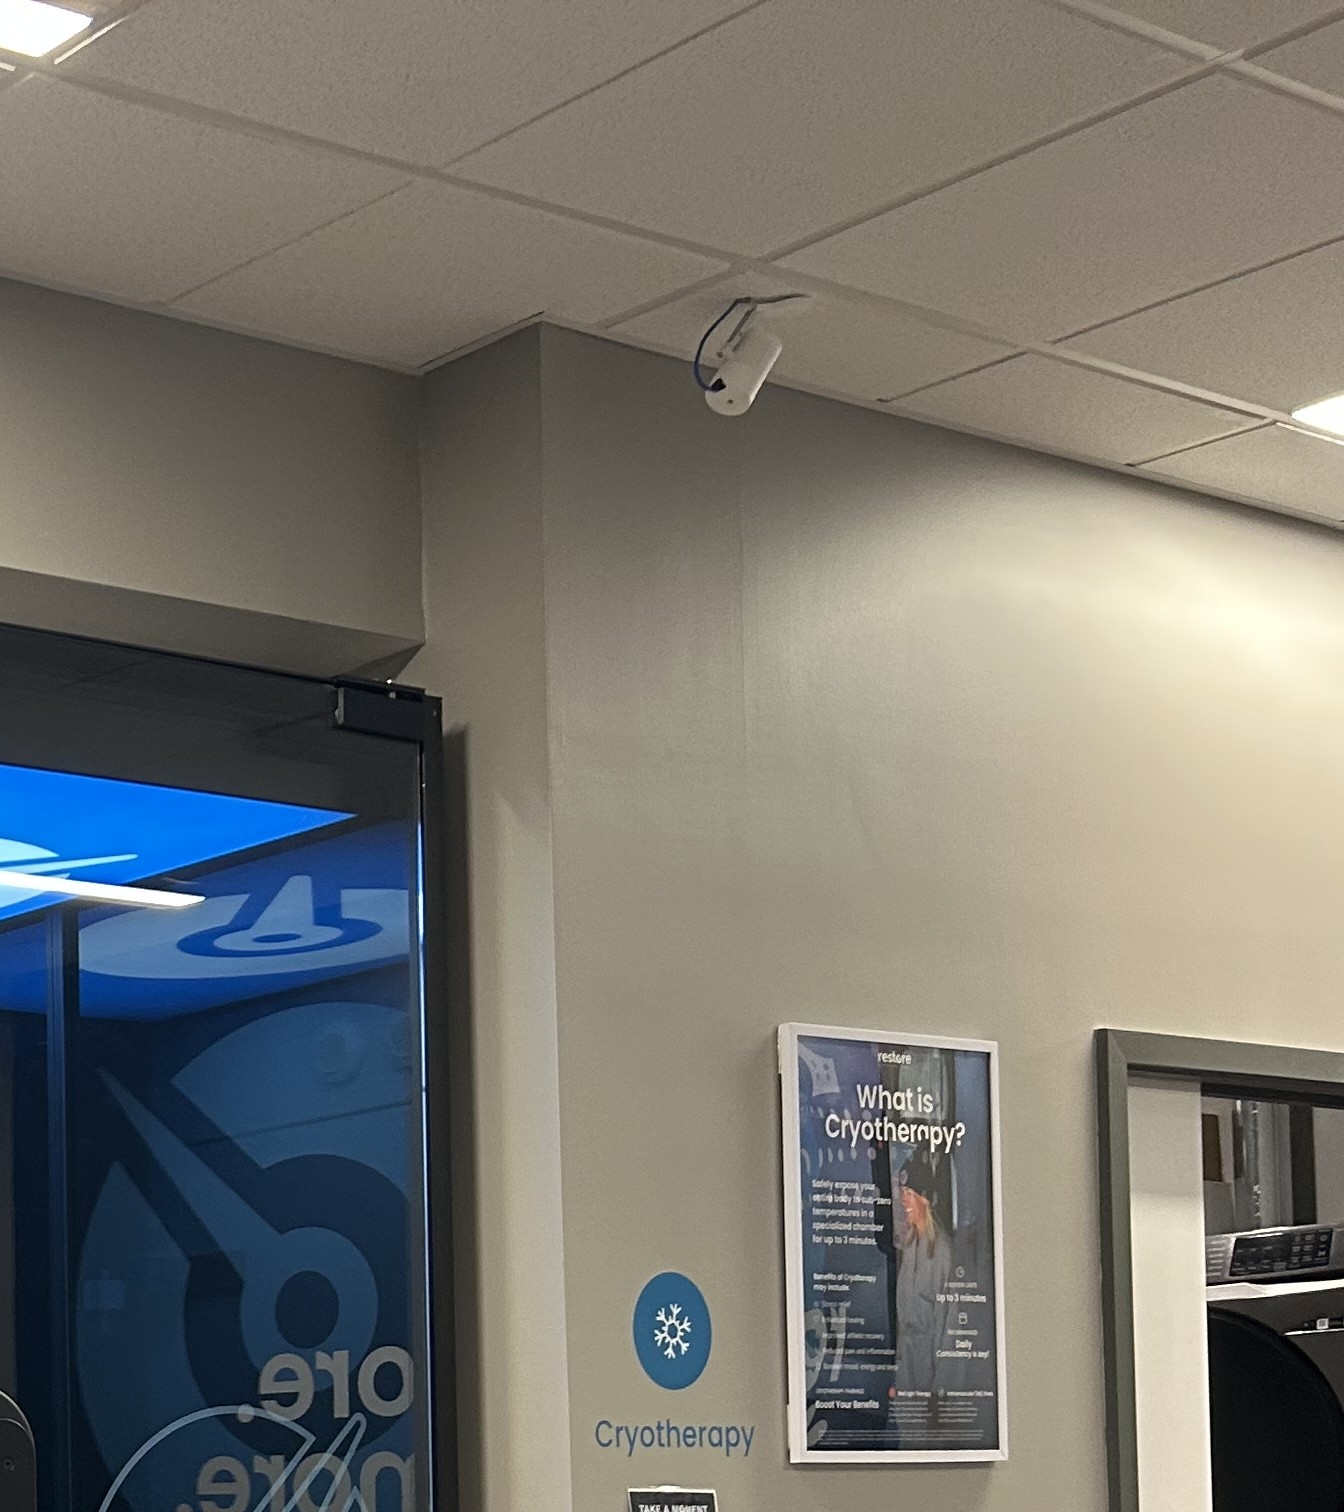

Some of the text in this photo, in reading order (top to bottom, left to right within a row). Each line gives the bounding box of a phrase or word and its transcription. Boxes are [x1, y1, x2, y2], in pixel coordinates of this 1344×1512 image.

[877, 1051, 912, 1064] restore
[856, 1084, 934, 1113] What is
[825, 1113, 966, 1154] Cryotherapy?
[812, 1179, 833, 1190] Safely
[812, 1208, 860, 1218] temperatures
[861, 1209, 867, 1217] in
[812, 1235, 822, 1243] for
[823, 1237, 833, 1246] up
[843, 1236, 848, 1244] 3
[946, 1294, 953, 1302] to
[954, 1293, 959, 1302] 3
[815, 1400, 880, 1409] Boost Your Benefits
[595, 1418, 755, 1457] Cryotherapy
